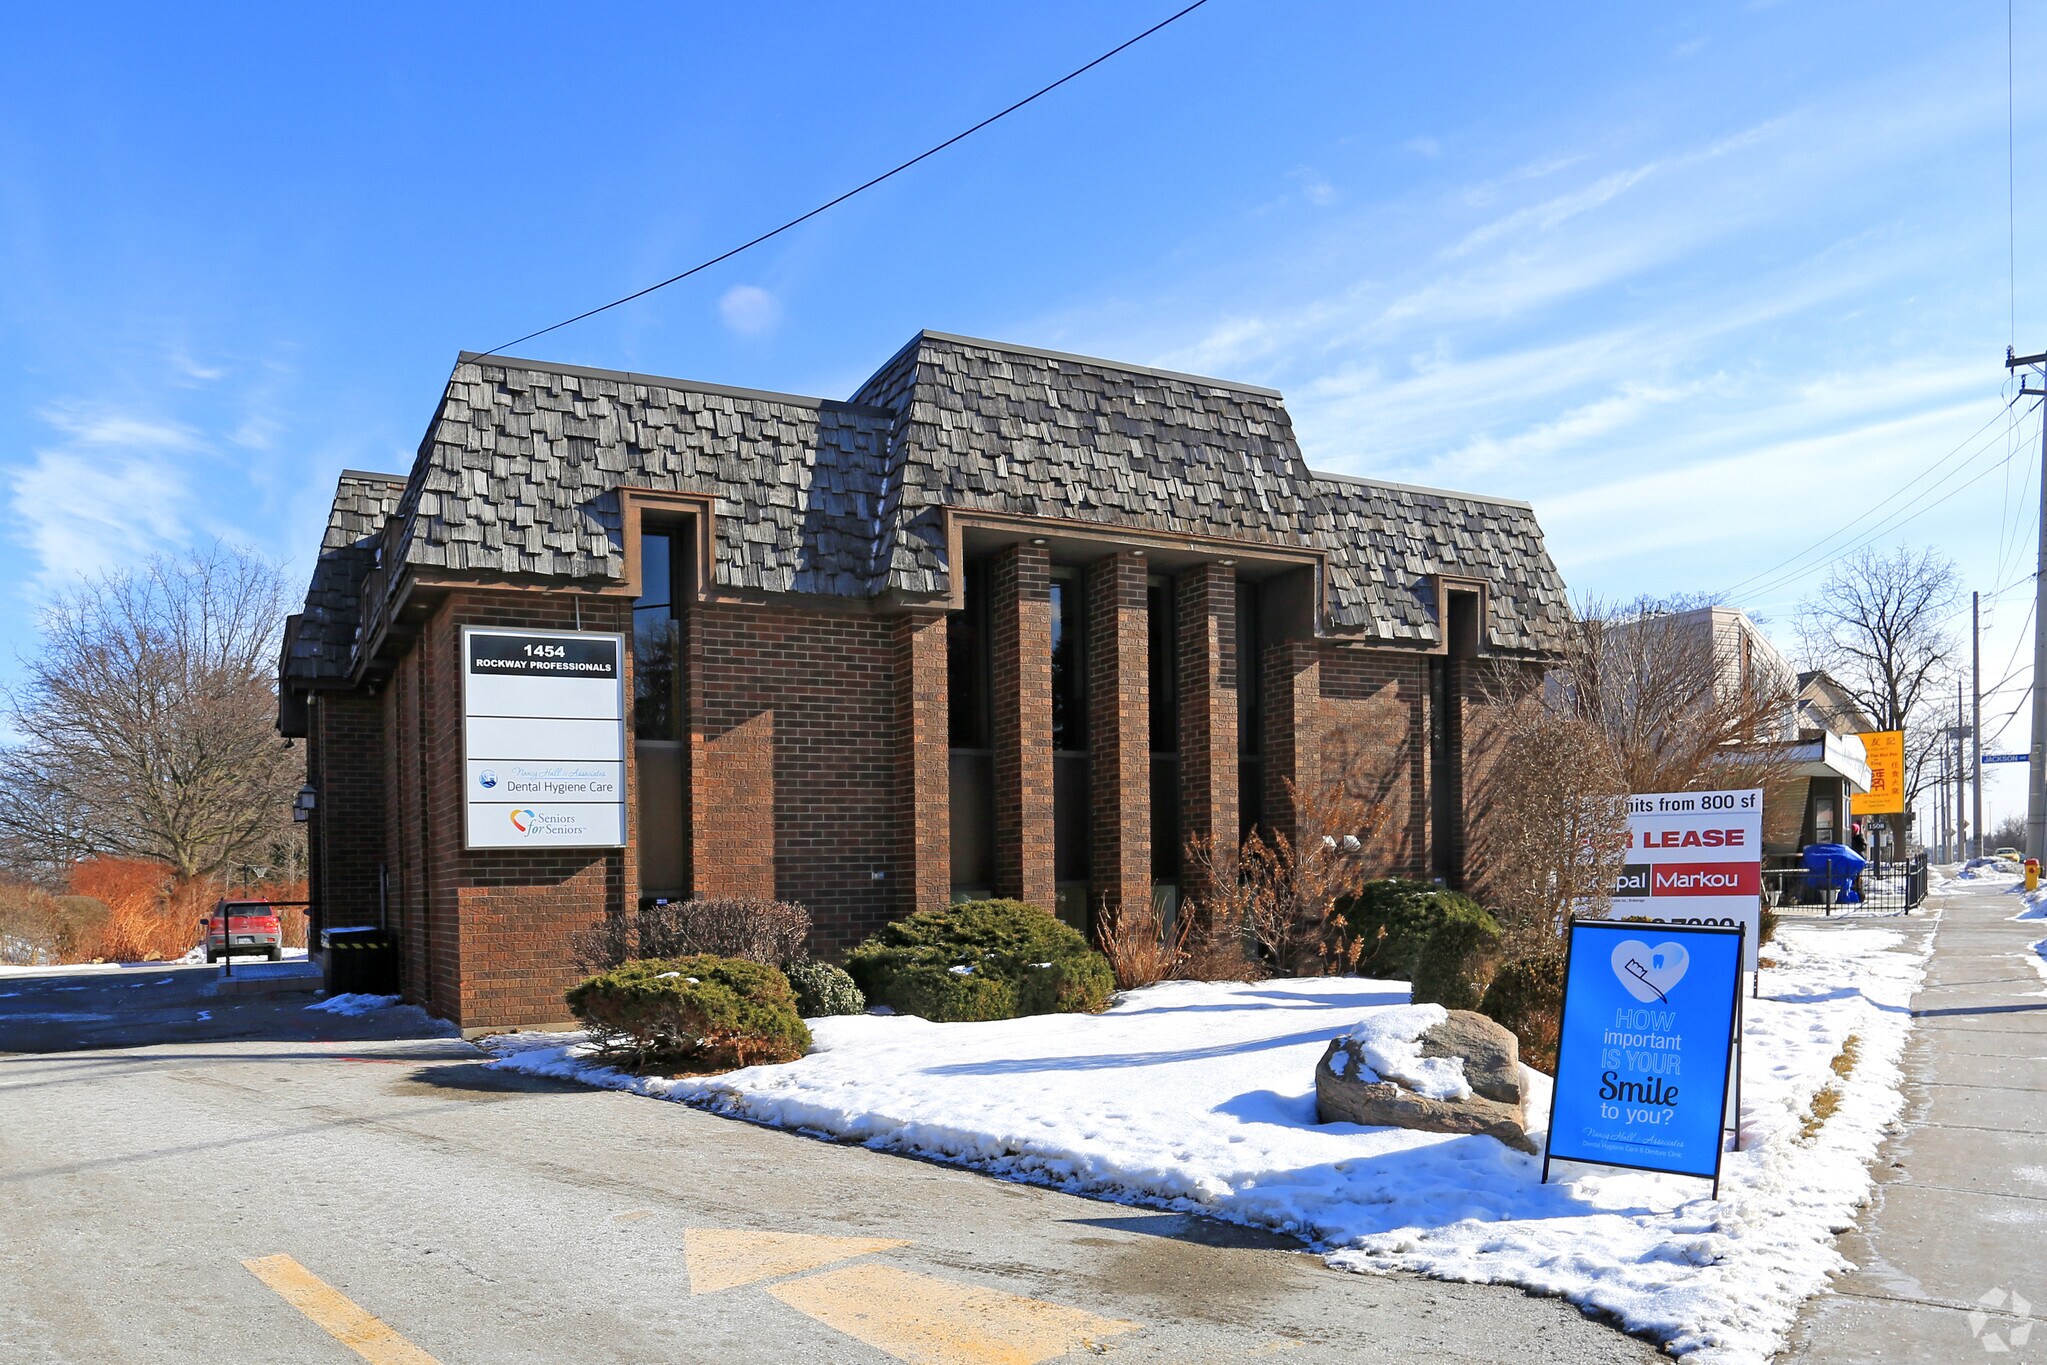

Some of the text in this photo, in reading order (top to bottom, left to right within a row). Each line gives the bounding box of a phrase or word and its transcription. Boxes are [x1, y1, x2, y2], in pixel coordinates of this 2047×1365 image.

[523, 644, 566, 658] 1454
[476, 659, 612, 672] ROCKWAY PROFESSIONALS
[1983, 755, 2018, 763] JACKSON
[568, 767, 607, 778] Associates
[507, 780, 614, 795] Dental Hygiene Care
[1625, 793, 1756, 812] nits from 800 sf
[538, 812, 576, 824] Seniors
[524, 819, 583, 838] for Seniors
[1643, 829, 1745, 848] LEASE
[1656, 871, 1738, 888] Markou
[1615, 1008, 1676, 1032] HOW
[1604, 1028, 1682, 1051] important
[1601, 1048, 1681, 1076] IS YOUR
[1598, 1070, 1679, 1107] Smile
[1600, 1102, 1674, 1126] to you?
